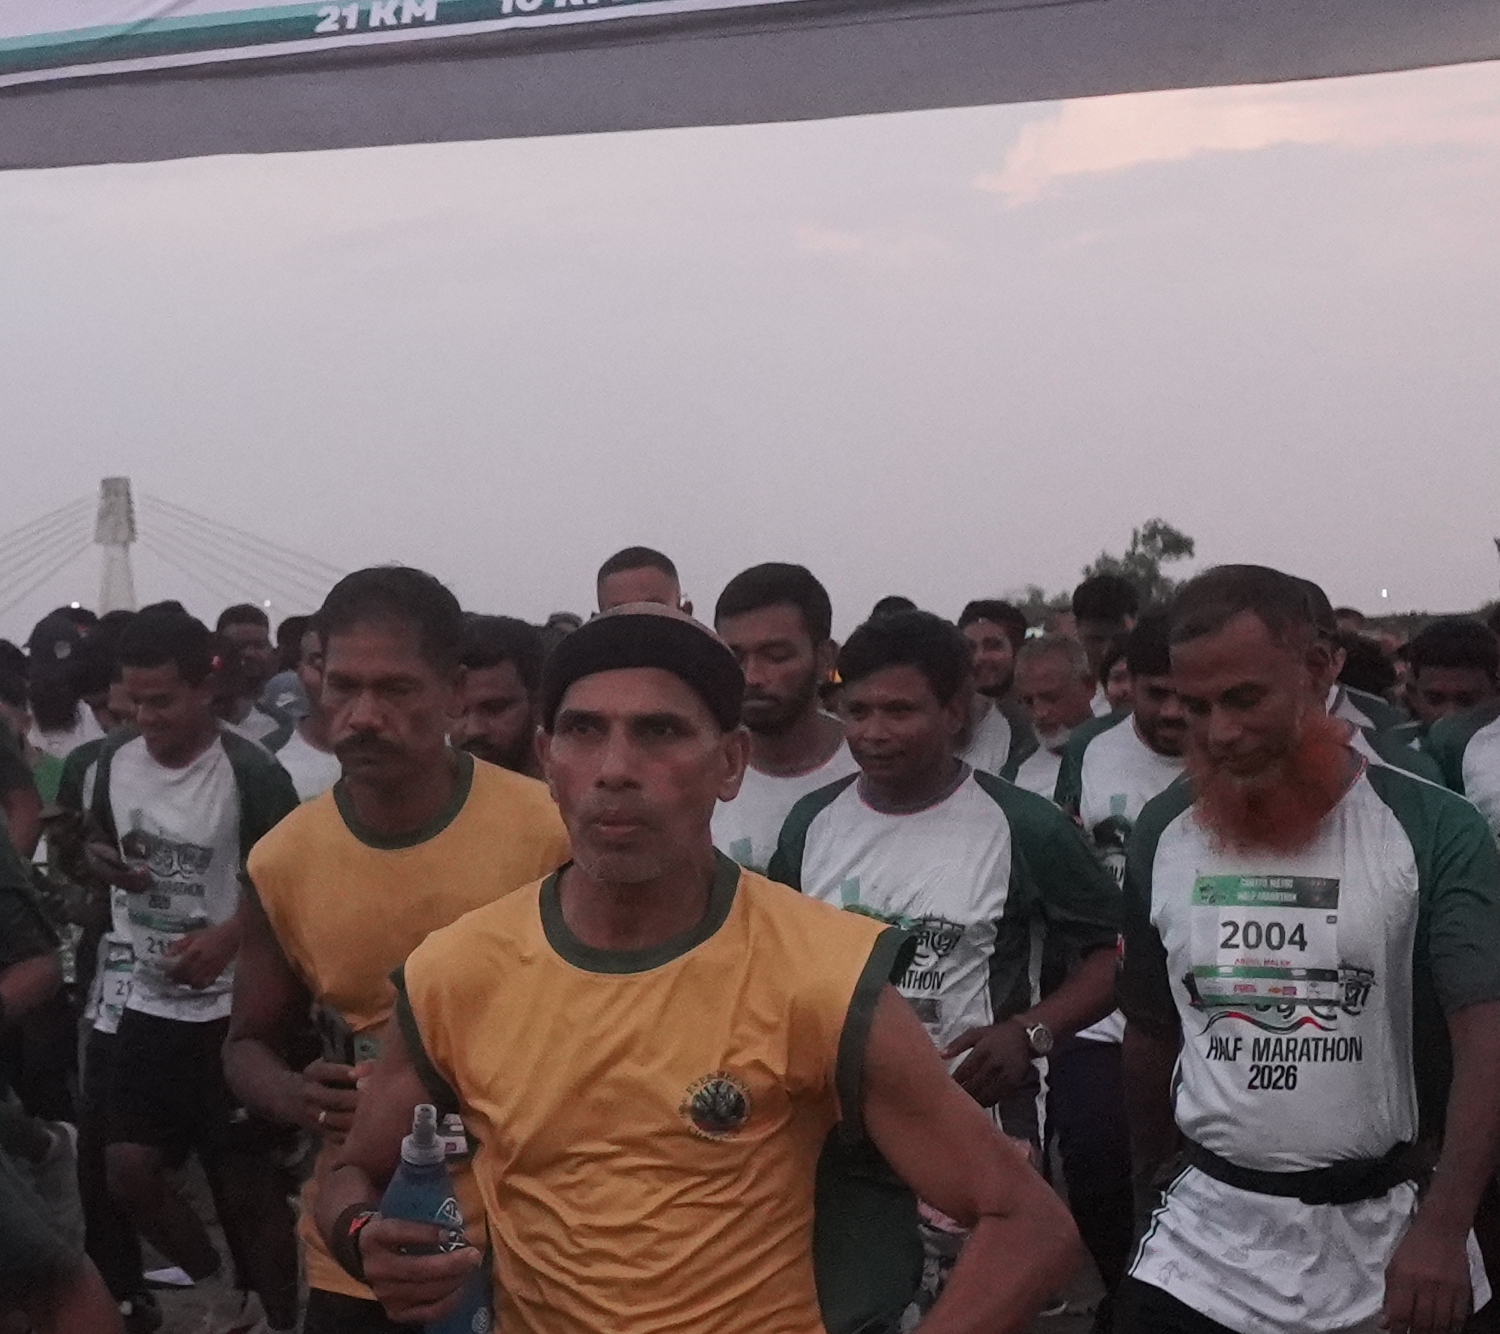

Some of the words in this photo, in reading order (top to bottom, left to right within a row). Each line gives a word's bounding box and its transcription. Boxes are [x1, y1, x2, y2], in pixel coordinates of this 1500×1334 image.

[314, 3, 359, 33] 21
[1220, 920, 1308, 951] 2004
[899, 970, 946, 990] ATHON
[1206, 1036, 1243, 1062] HALF
[1251, 1036, 1363, 1063] MARATHON
[1247, 1065, 1298, 1090] 2026
